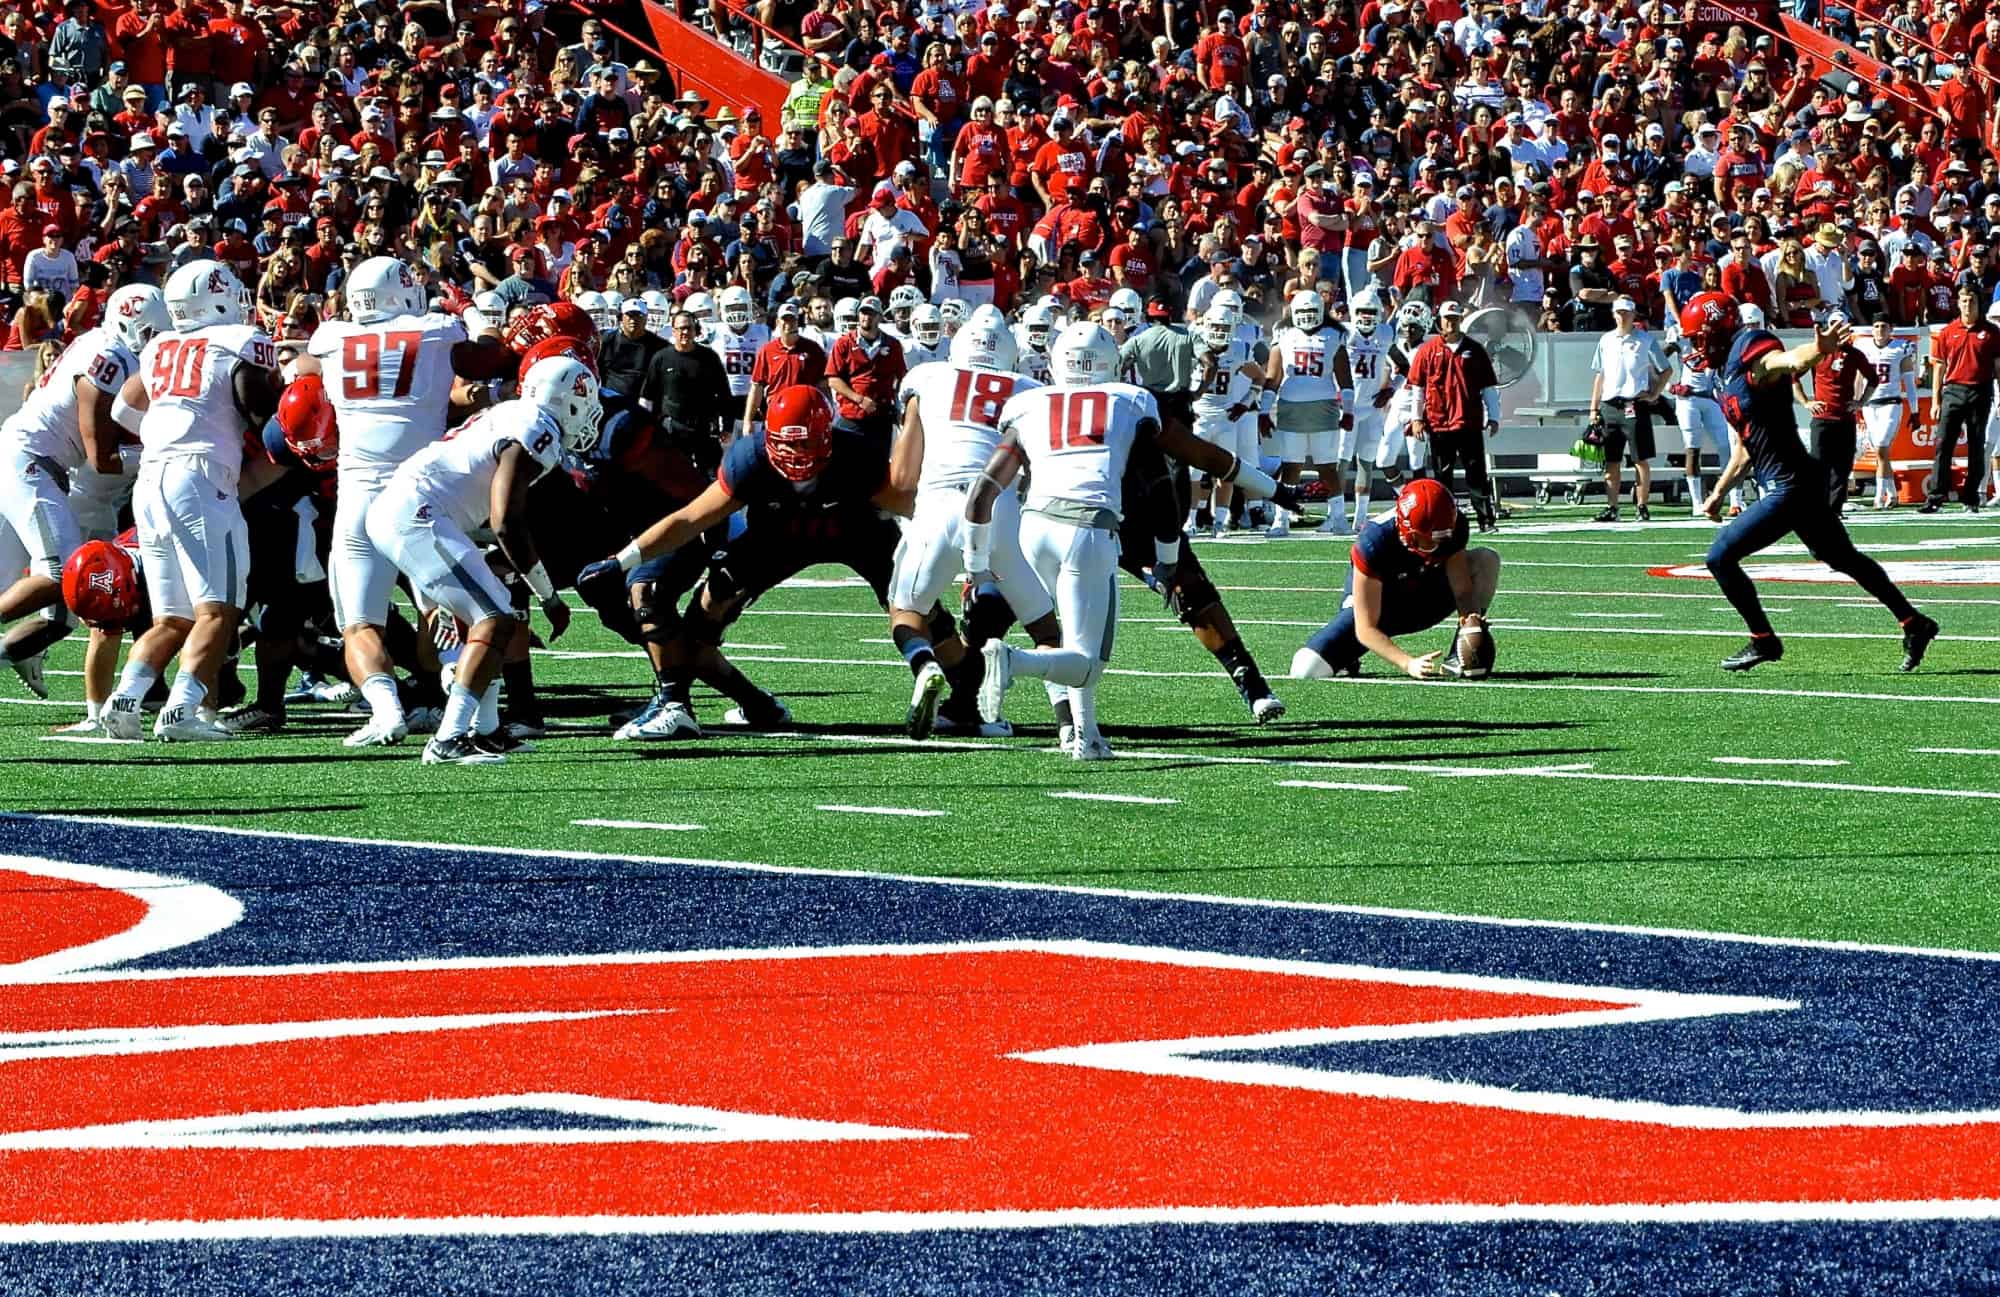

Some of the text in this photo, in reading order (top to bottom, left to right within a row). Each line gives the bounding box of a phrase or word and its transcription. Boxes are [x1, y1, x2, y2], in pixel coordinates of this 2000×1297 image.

[1697, 6, 1732, 22] ECTION
[253, 342, 277, 367] 90
[342, 331, 423, 400] 97
[726, 352, 756, 376] 63
[1294, 351, 1324, 377] 95
[1355, 354, 1377, 379] 41
[88, 354, 119, 385] 99
[150, 338, 209, 401] 90
[950, 369, 1014, 427] 18
[1050, 392, 1108, 450] 10
[533, 430, 553, 454] 8
[89, 570, 113, 593] A
[112, 698, 137, 713] NIKE
